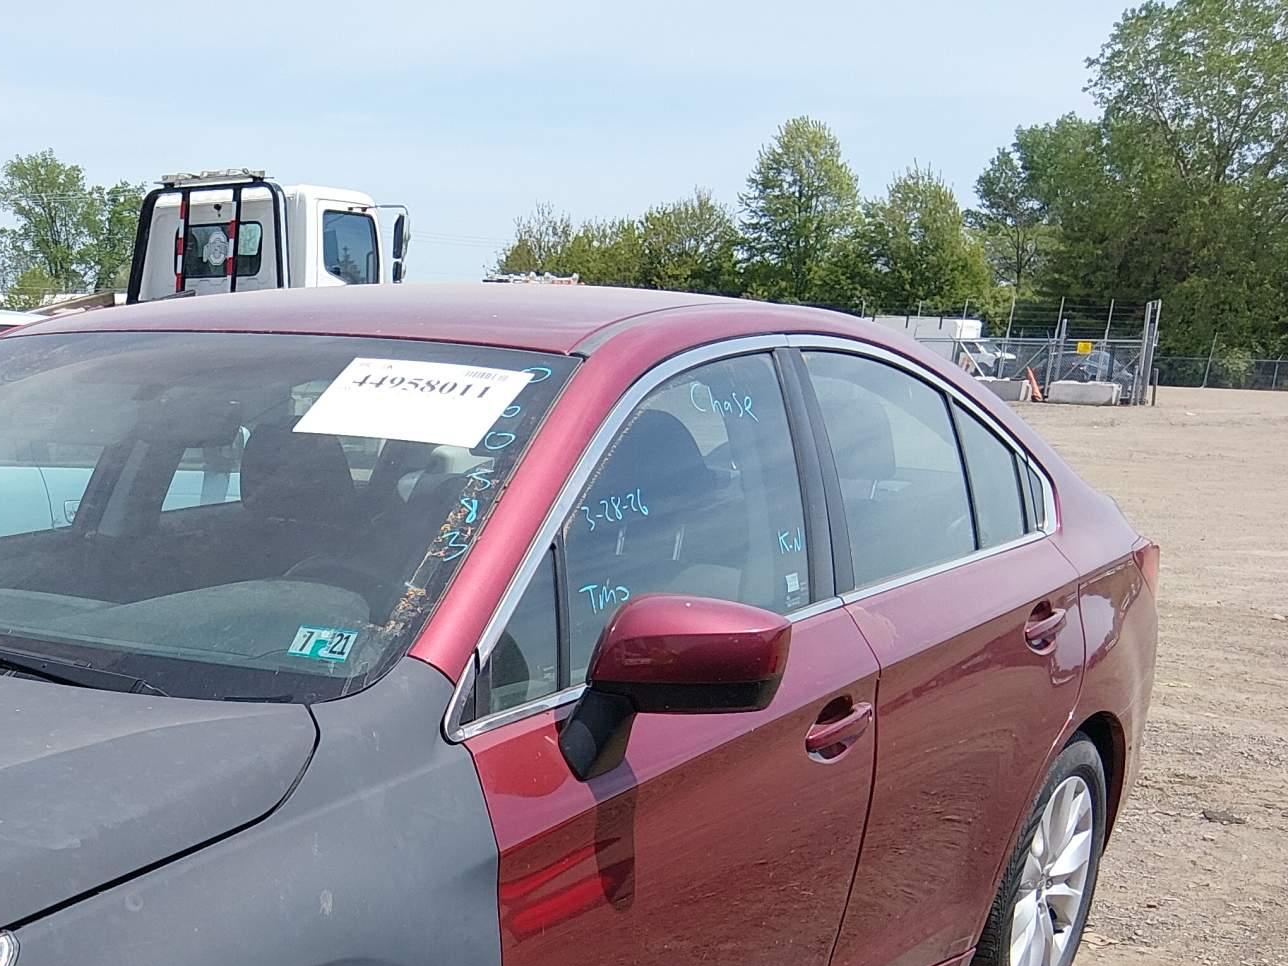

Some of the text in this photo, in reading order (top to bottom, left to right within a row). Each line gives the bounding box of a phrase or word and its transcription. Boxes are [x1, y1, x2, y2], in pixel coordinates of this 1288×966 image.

[352, 374, 492, 399] 44958011
[690, 383, 760, 423] Chase
[580, 488, 649, 532] 3-28-26
[329, 632, 352, 656] 21
